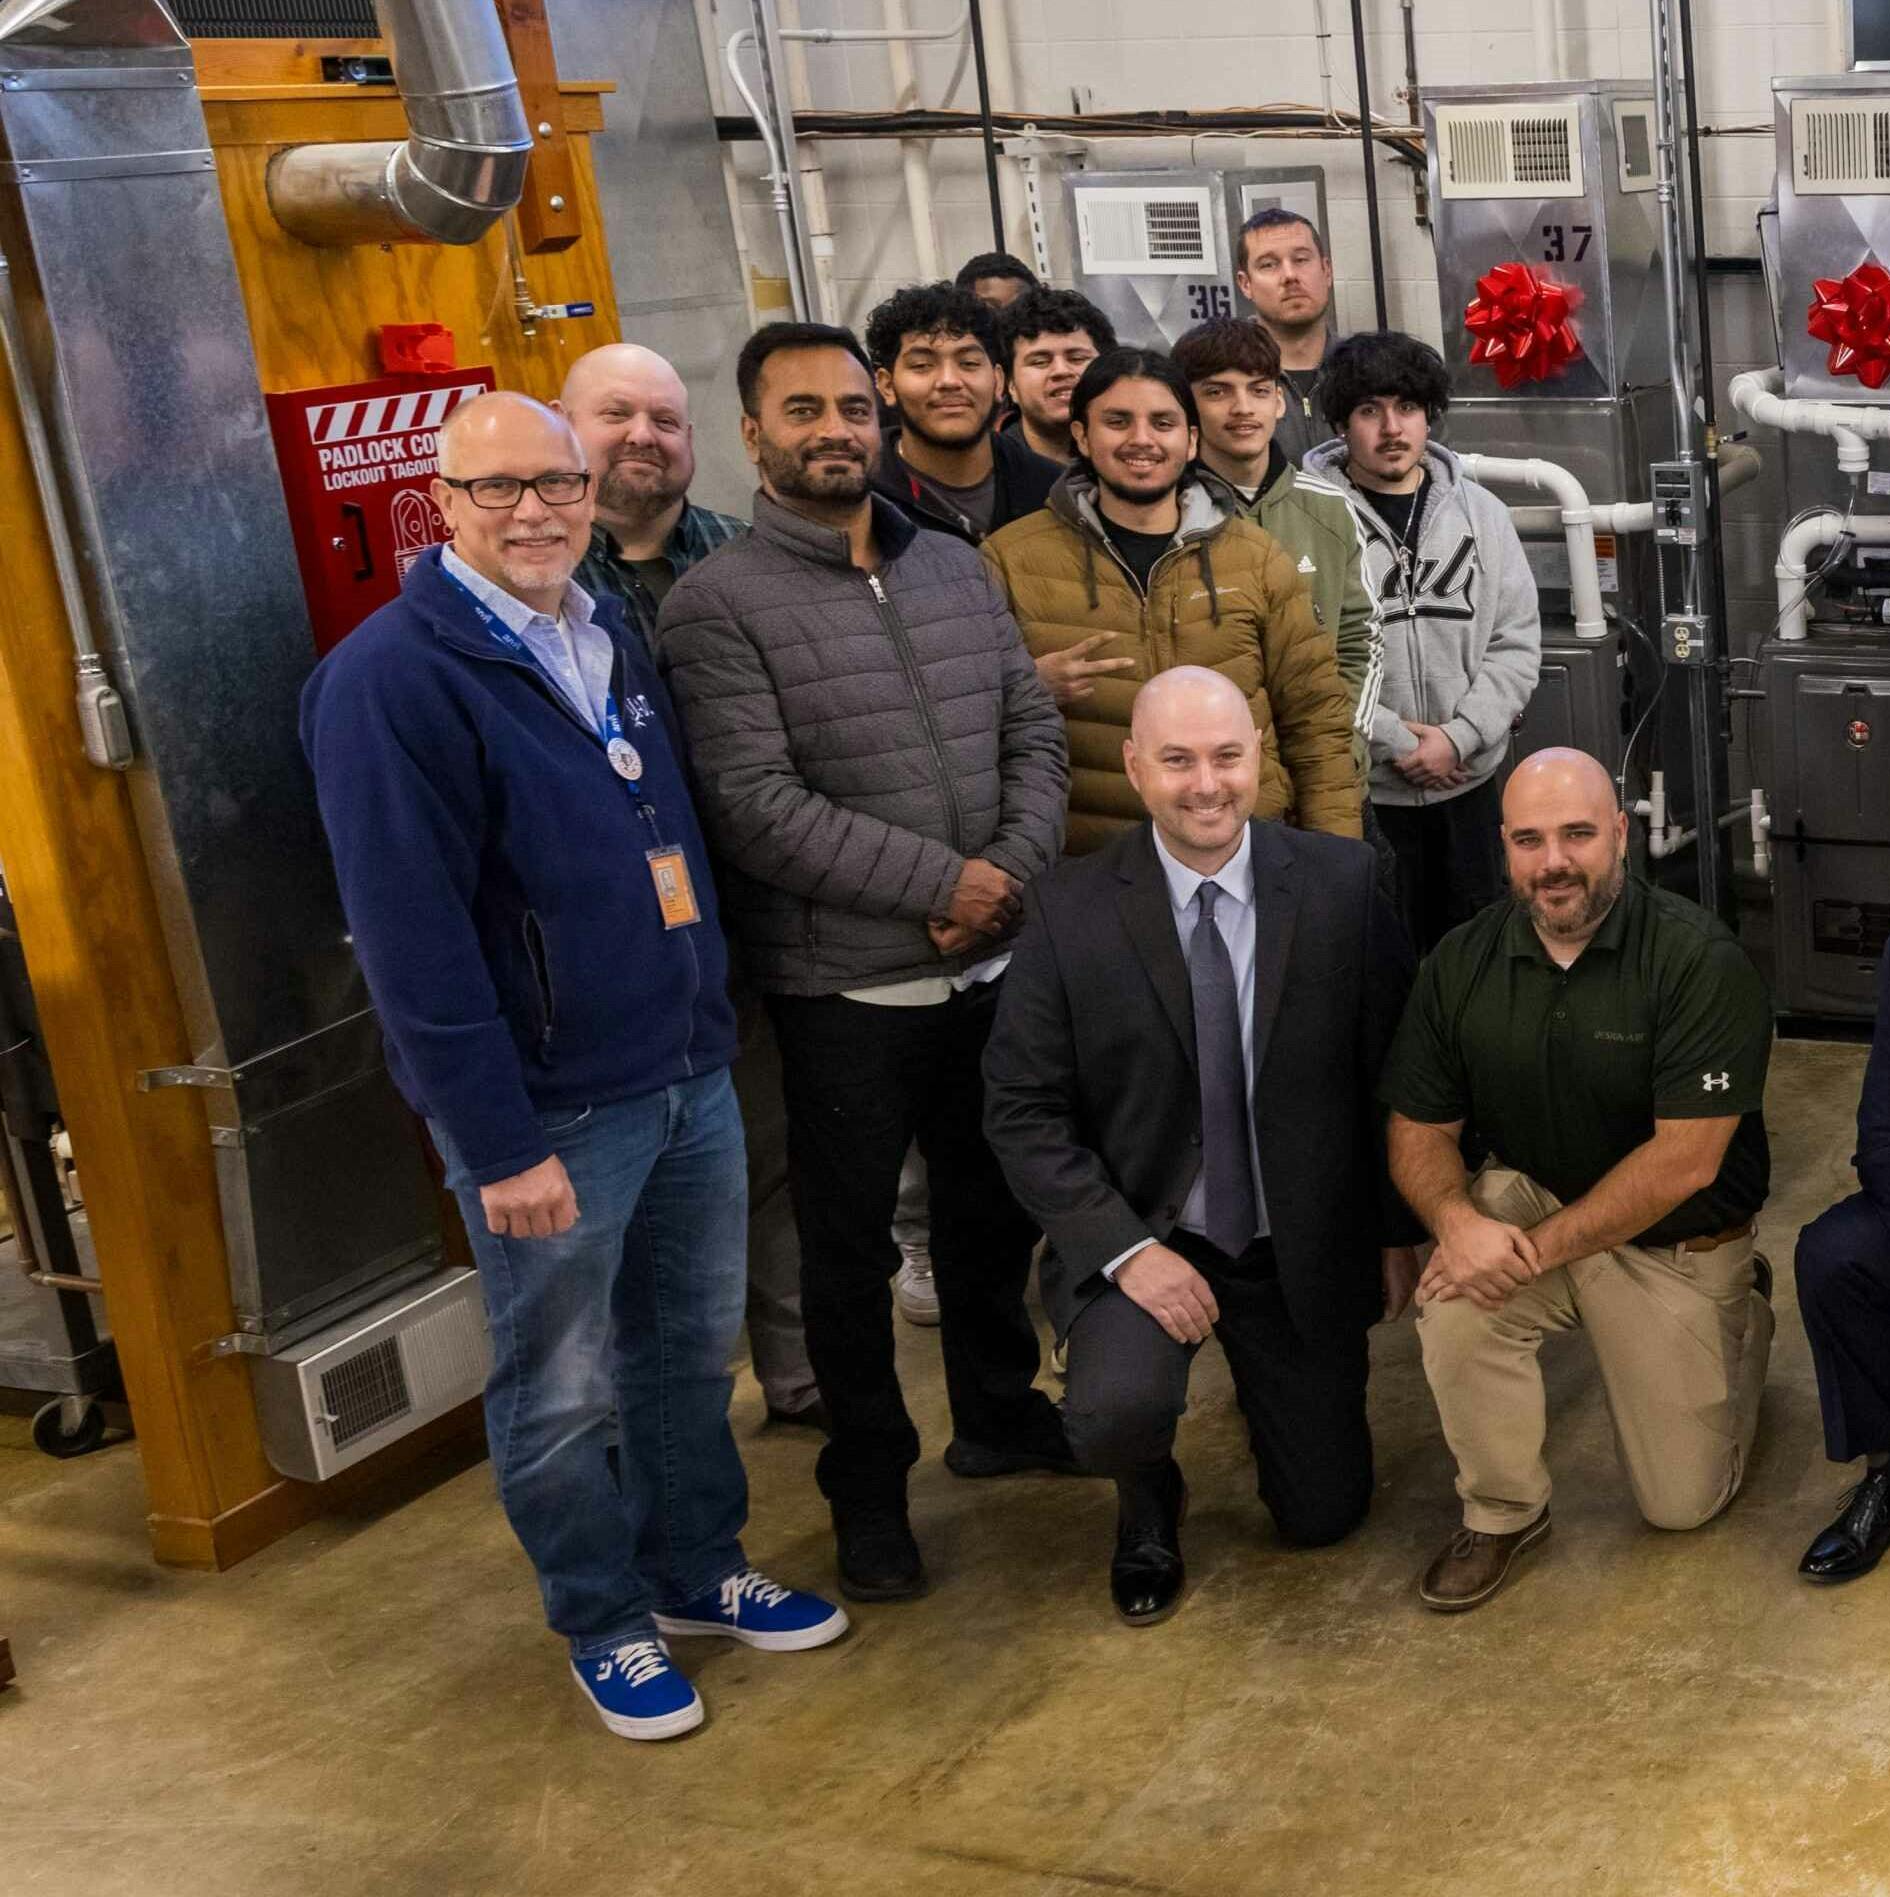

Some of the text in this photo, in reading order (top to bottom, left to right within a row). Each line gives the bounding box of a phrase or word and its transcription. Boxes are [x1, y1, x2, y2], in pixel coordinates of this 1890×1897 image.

[1543, 225, 1592, 262] 37
[1188, 284, 1231, 319] 36
[318, 437, 407, 471] PADLOCK
[323, 456, 440, 491] LOCKOUT TAGOUT
